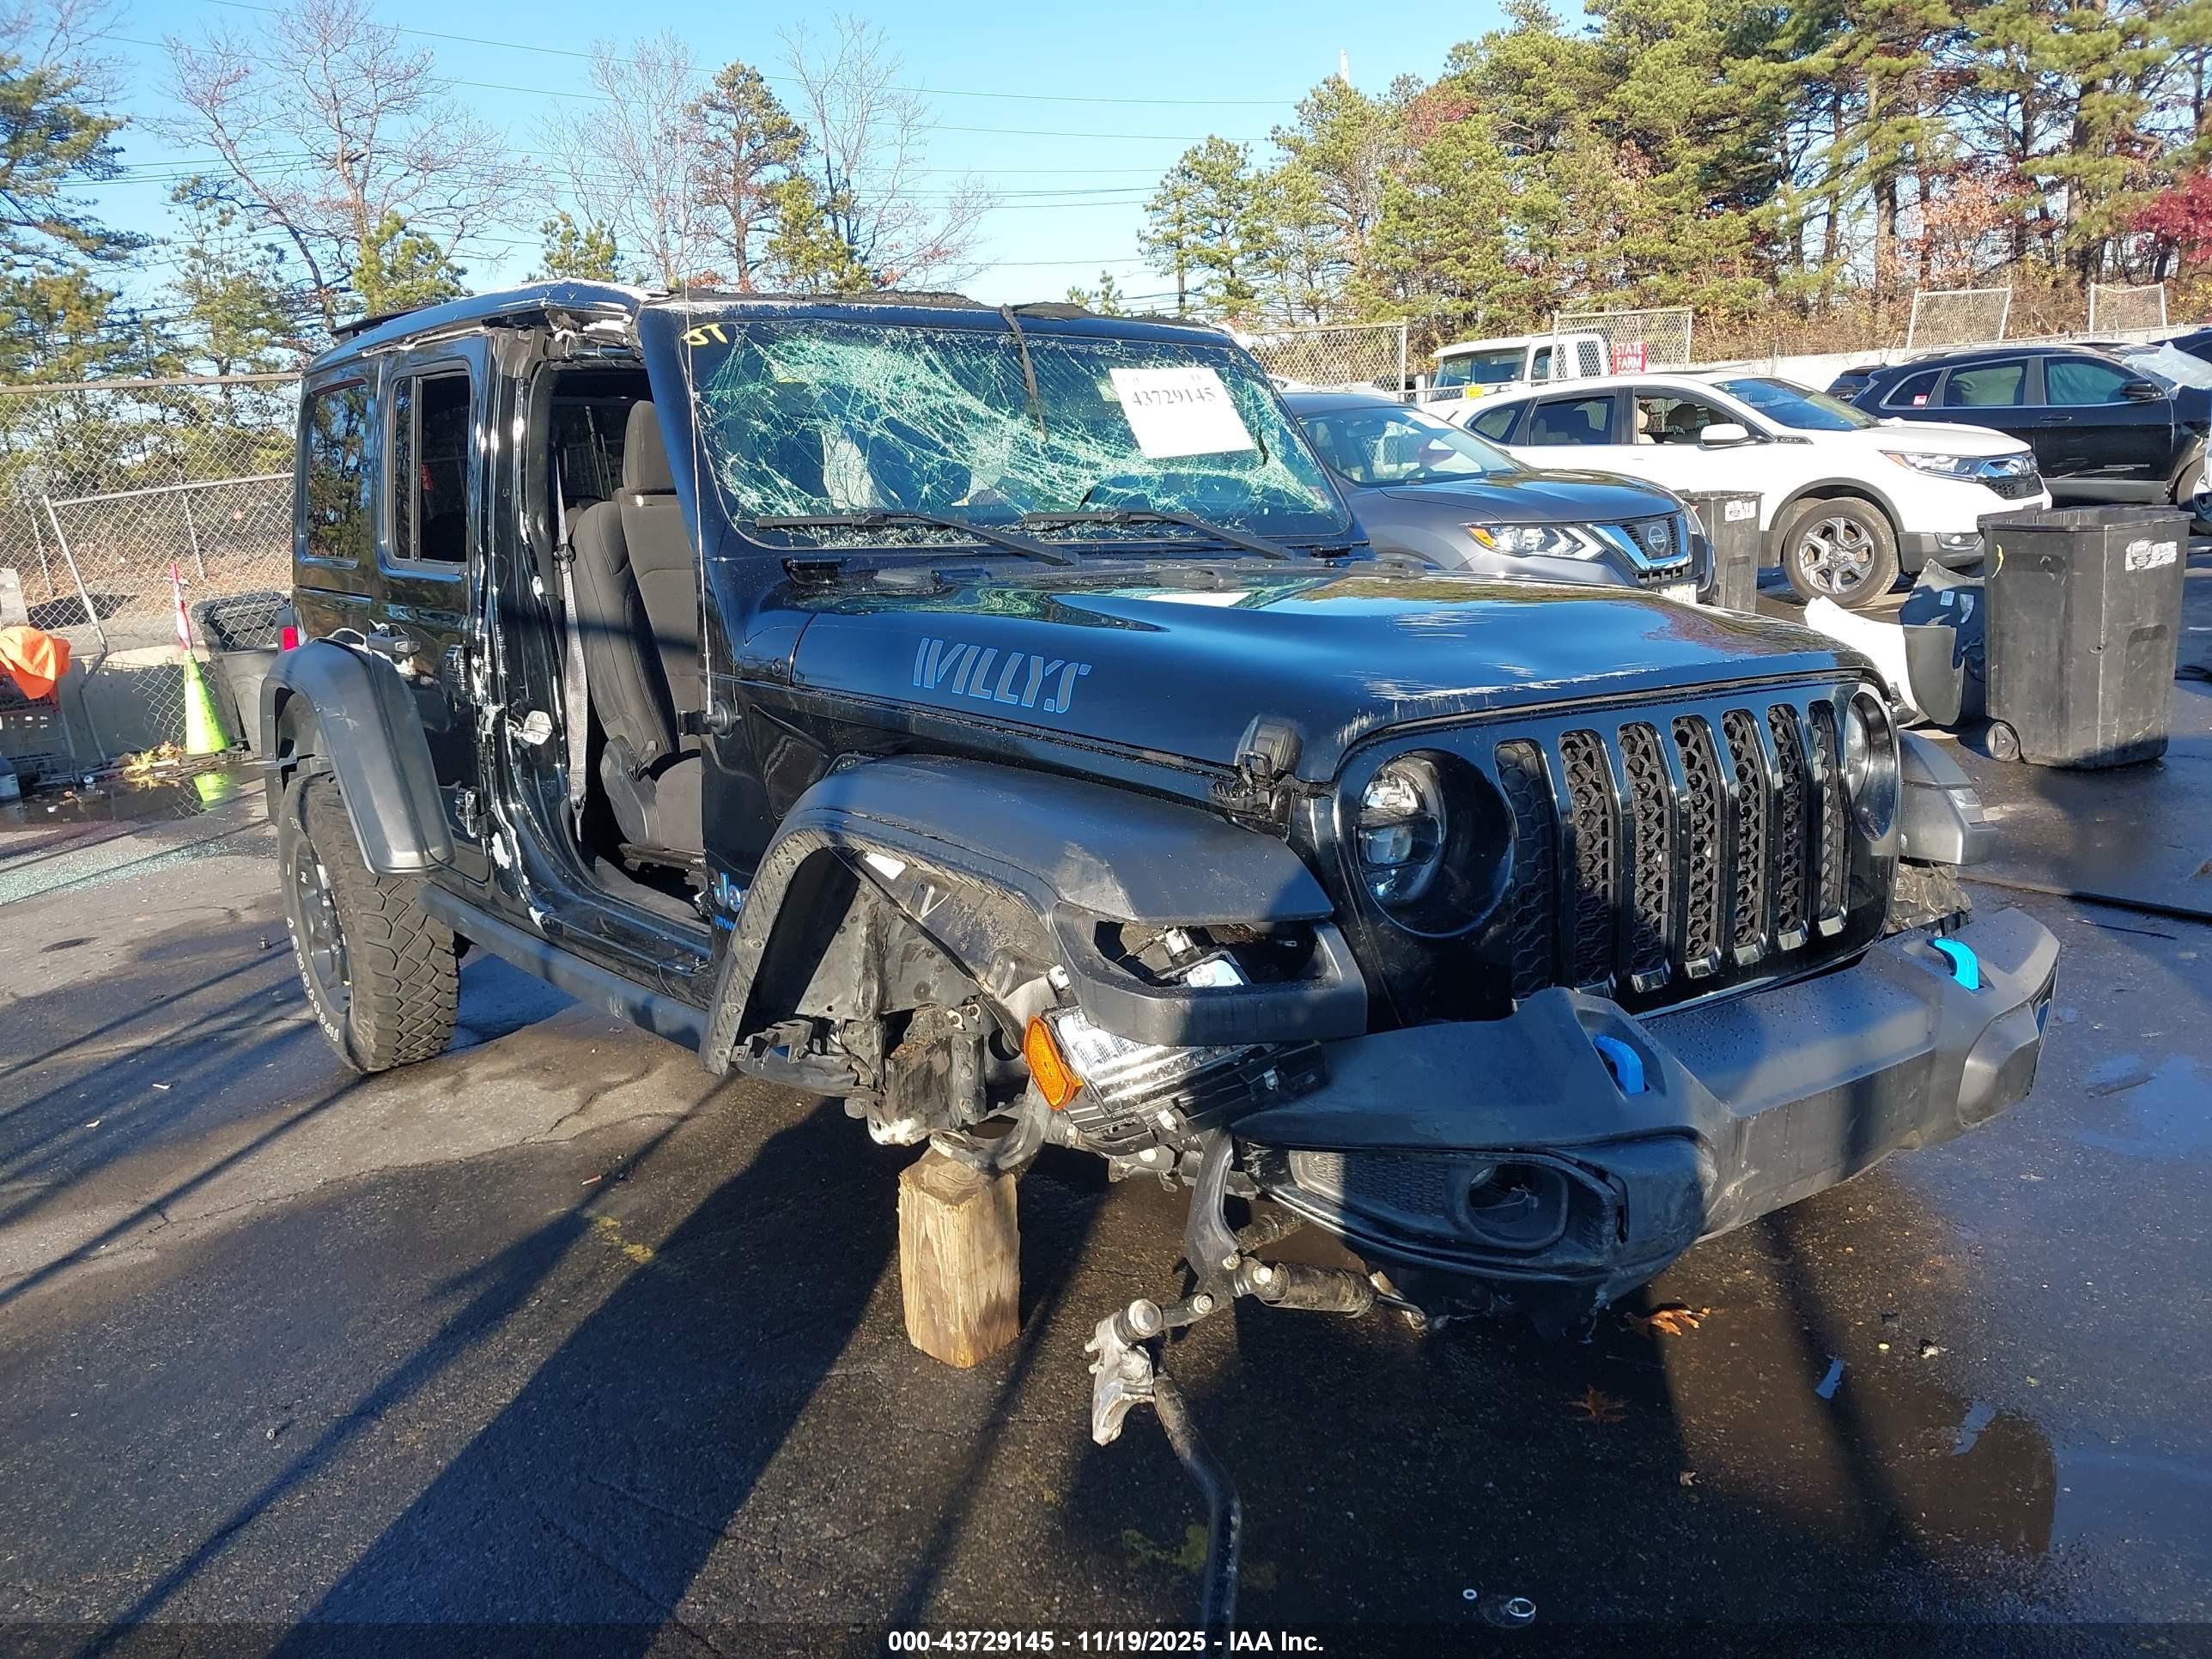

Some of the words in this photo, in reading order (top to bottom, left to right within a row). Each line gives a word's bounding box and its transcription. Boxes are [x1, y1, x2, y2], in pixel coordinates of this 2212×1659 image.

[1615, 343, 1642, 356] STATE
[1616, 356, 1642, 369] FARM
[1132, 386, 1216, 406] 43729145
[913, 637, 1093, 714] WILLYS
